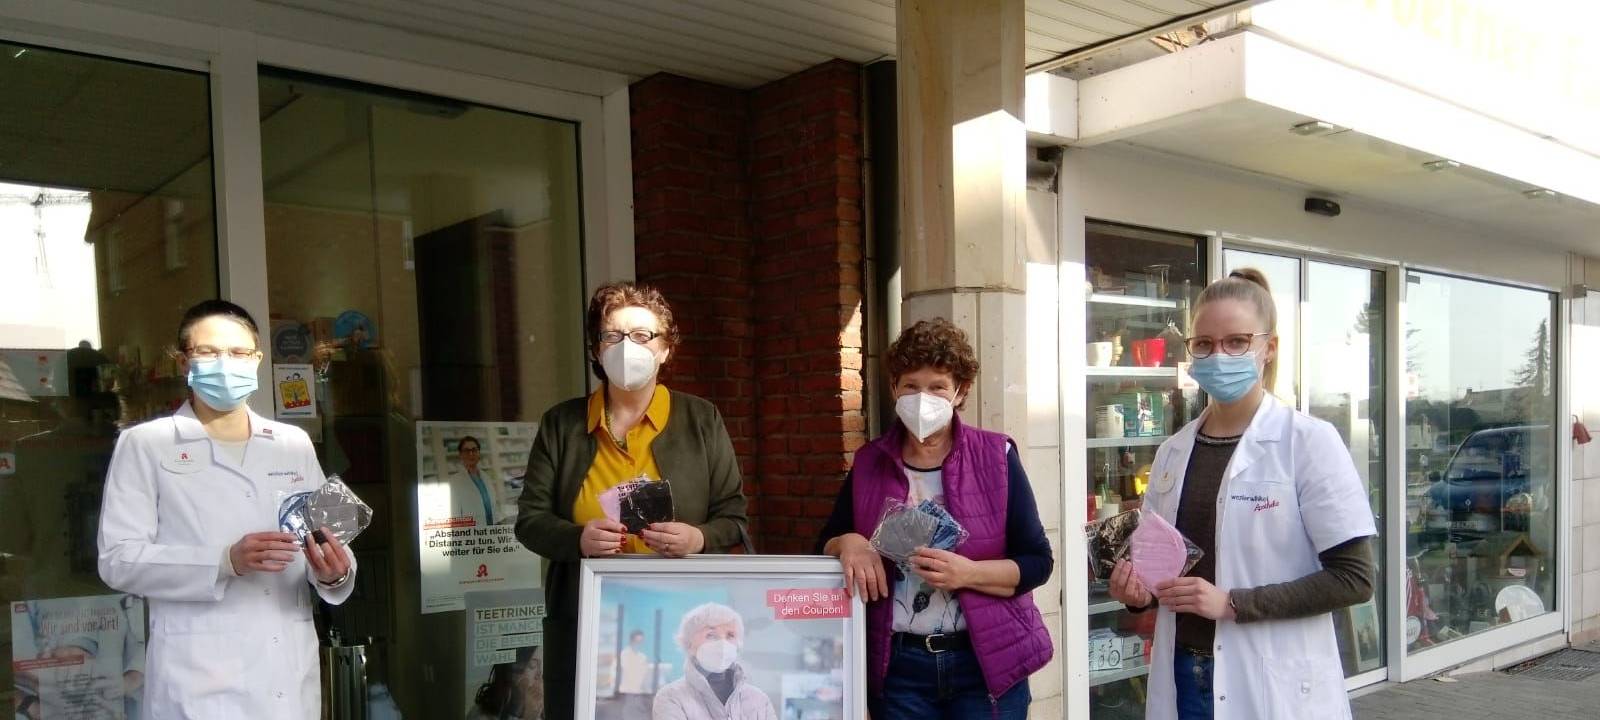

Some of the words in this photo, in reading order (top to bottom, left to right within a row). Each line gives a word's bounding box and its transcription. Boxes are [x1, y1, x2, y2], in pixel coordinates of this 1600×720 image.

[473, 527, 487, 536] hat
[429, 540, 462, 548] Distanz
[497, 536, 513, 544] Wir
[442, 547, 469, 556] weiter
[472, 546, 484, 555] für
[487, 545, 501, 554] Sie
[773, 593, 810, 603] Denken
[812, 592, 830, 602] Sie
[831, 593, 843, 601] an
[781, 605, 800, 615] den
[802, 605, 844, 616] Coupon!
[40, 619, 56, 633] Wir
[81, 620, 97, 632] vor
[476, 623, 495, 634] IST
[476, 638, 497, 649] DIE
[476, 652, 515, 664] WAHL
